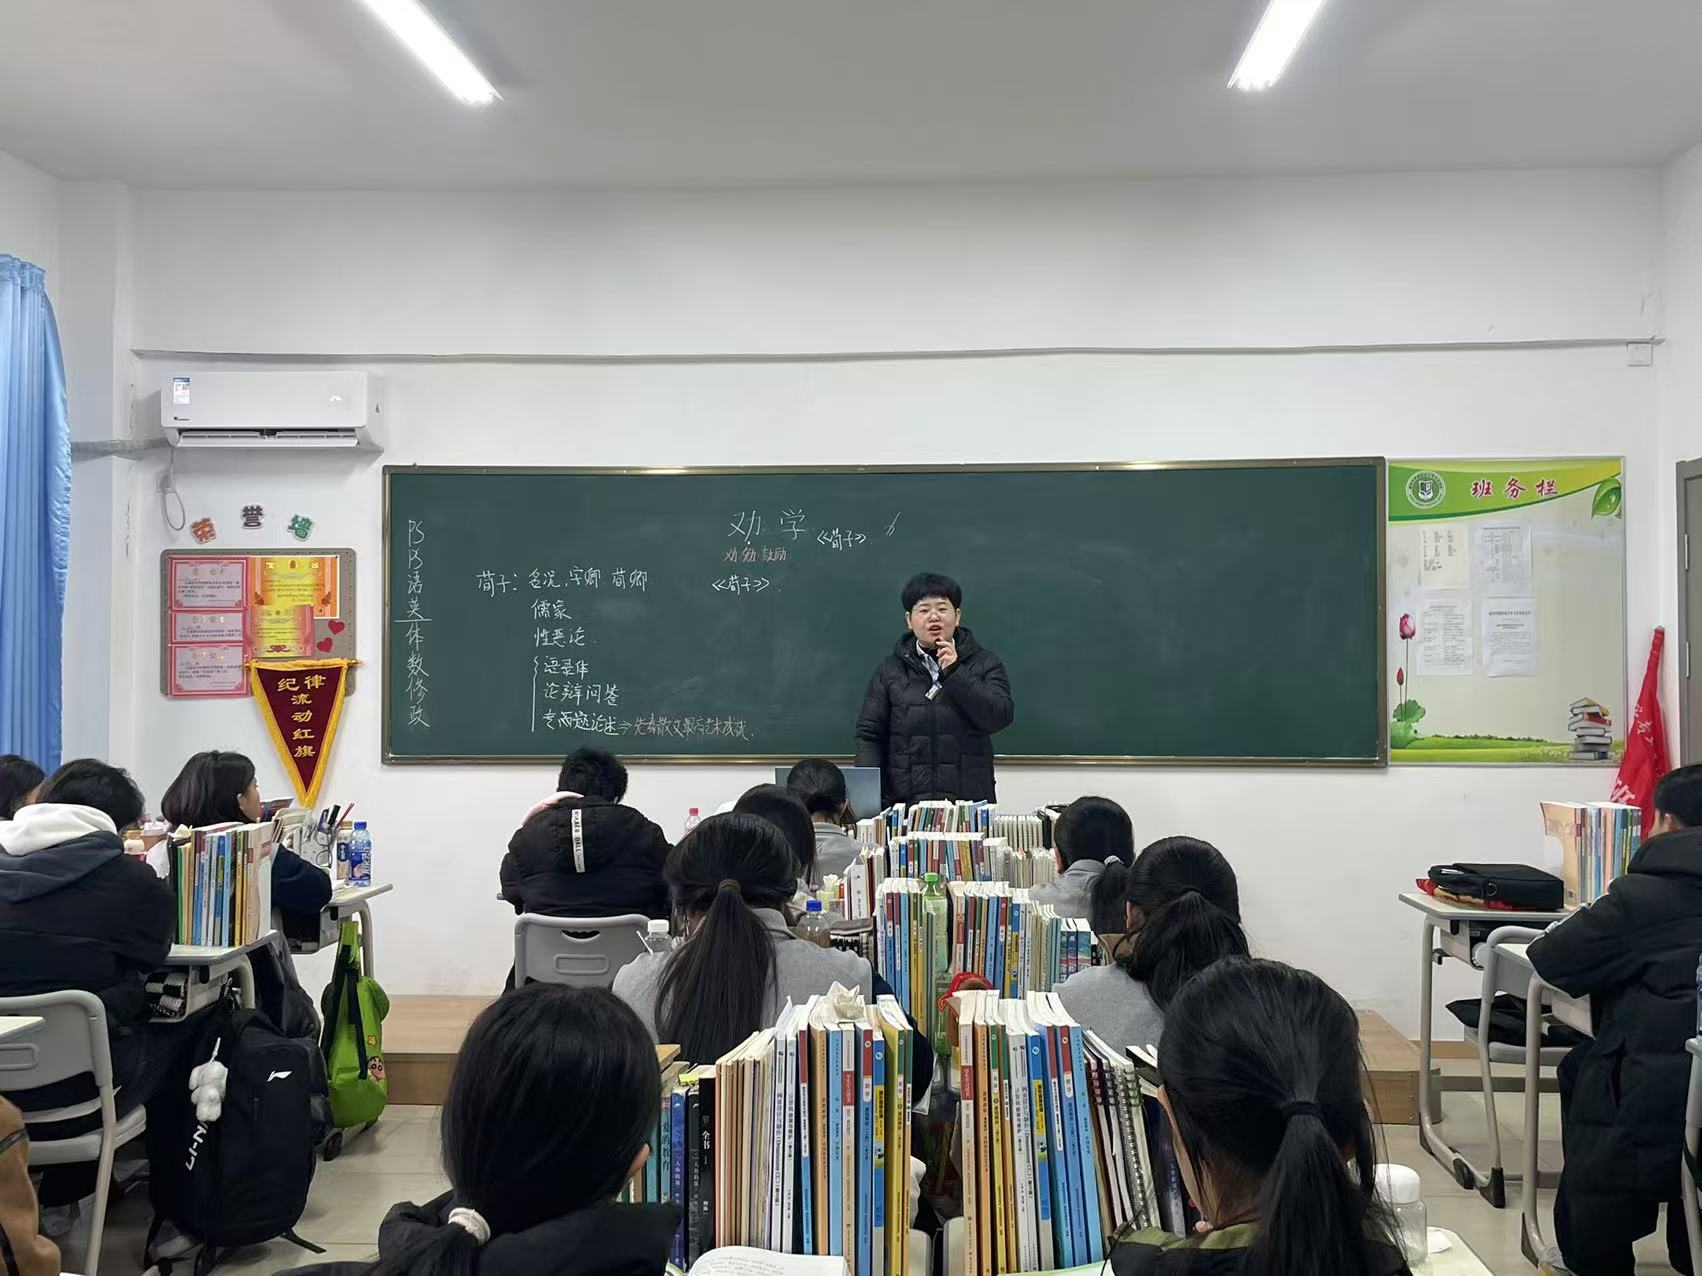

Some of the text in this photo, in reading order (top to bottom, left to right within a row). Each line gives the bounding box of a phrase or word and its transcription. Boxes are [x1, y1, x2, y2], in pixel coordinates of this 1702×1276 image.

[1471, 476, 1559, 499] 班务栏
[728, 509, 806, 541] 劝学
[531, 598, 572, 619] 儒家
[543, 656, 589, 680] 语录体
[277, 674, 326, 692] 纪律
[291, 693, 315, 758] 流动红旗
